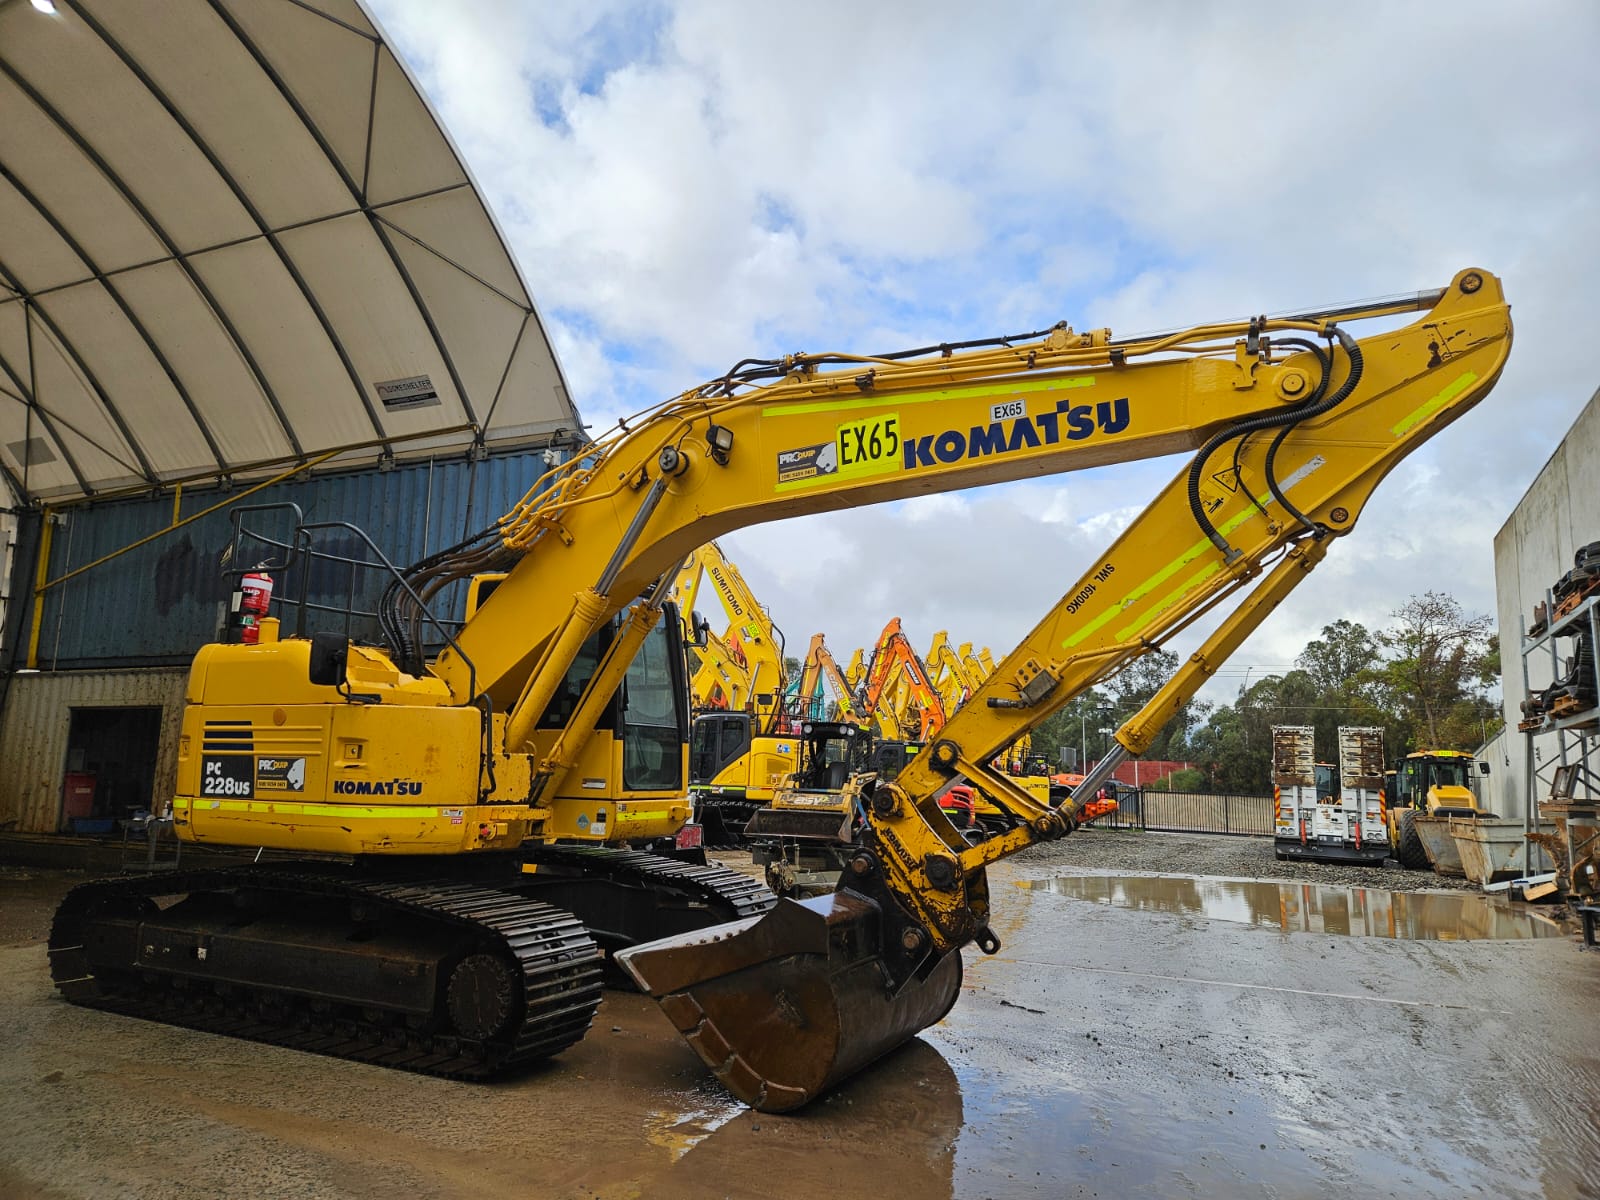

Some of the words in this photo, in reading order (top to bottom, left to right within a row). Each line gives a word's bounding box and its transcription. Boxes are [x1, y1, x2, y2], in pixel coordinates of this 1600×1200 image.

[994, 402, 1023, 419] EX65
[839, 419, 898, 466] EX65
[903, 397, 1131, 470] KOMATSU
[1094, 563, 1115, 582] SWL
[711, 567, 743, 616] SUMITOMO
[1066, 583, 1096, 614] 1600KG
[206, 761, 222, 776] PC
[204, 777, 250, 795] 228US
[333, 777, 422, 796] KOMATSU
